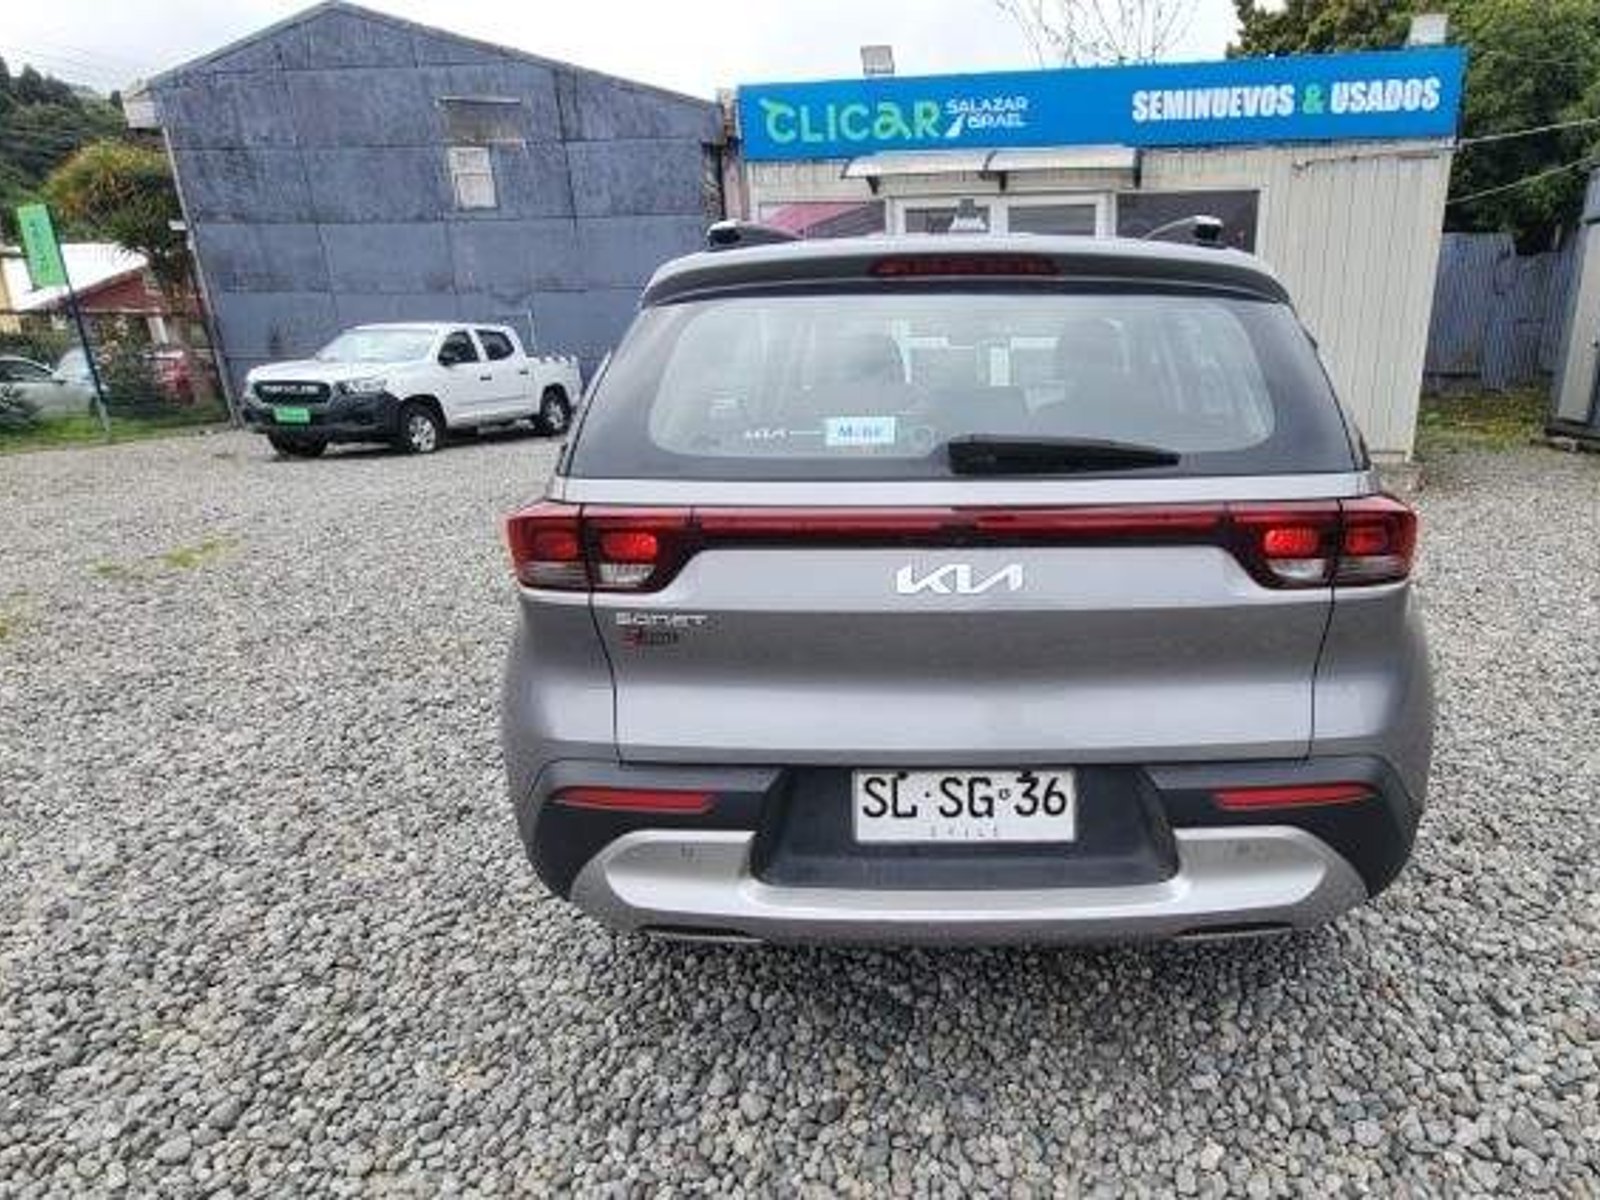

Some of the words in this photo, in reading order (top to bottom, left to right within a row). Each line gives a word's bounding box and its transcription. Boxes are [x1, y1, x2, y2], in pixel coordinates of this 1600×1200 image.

[945, 96, 1028, 114] SALAZAR
[1131, 84, 1295, 122] SEMINUEVOS
[1302, 82, 1325, 115] &
[1330, 77, 1440, 114] USADOS
[897, 563, 1022, 594] KIA
